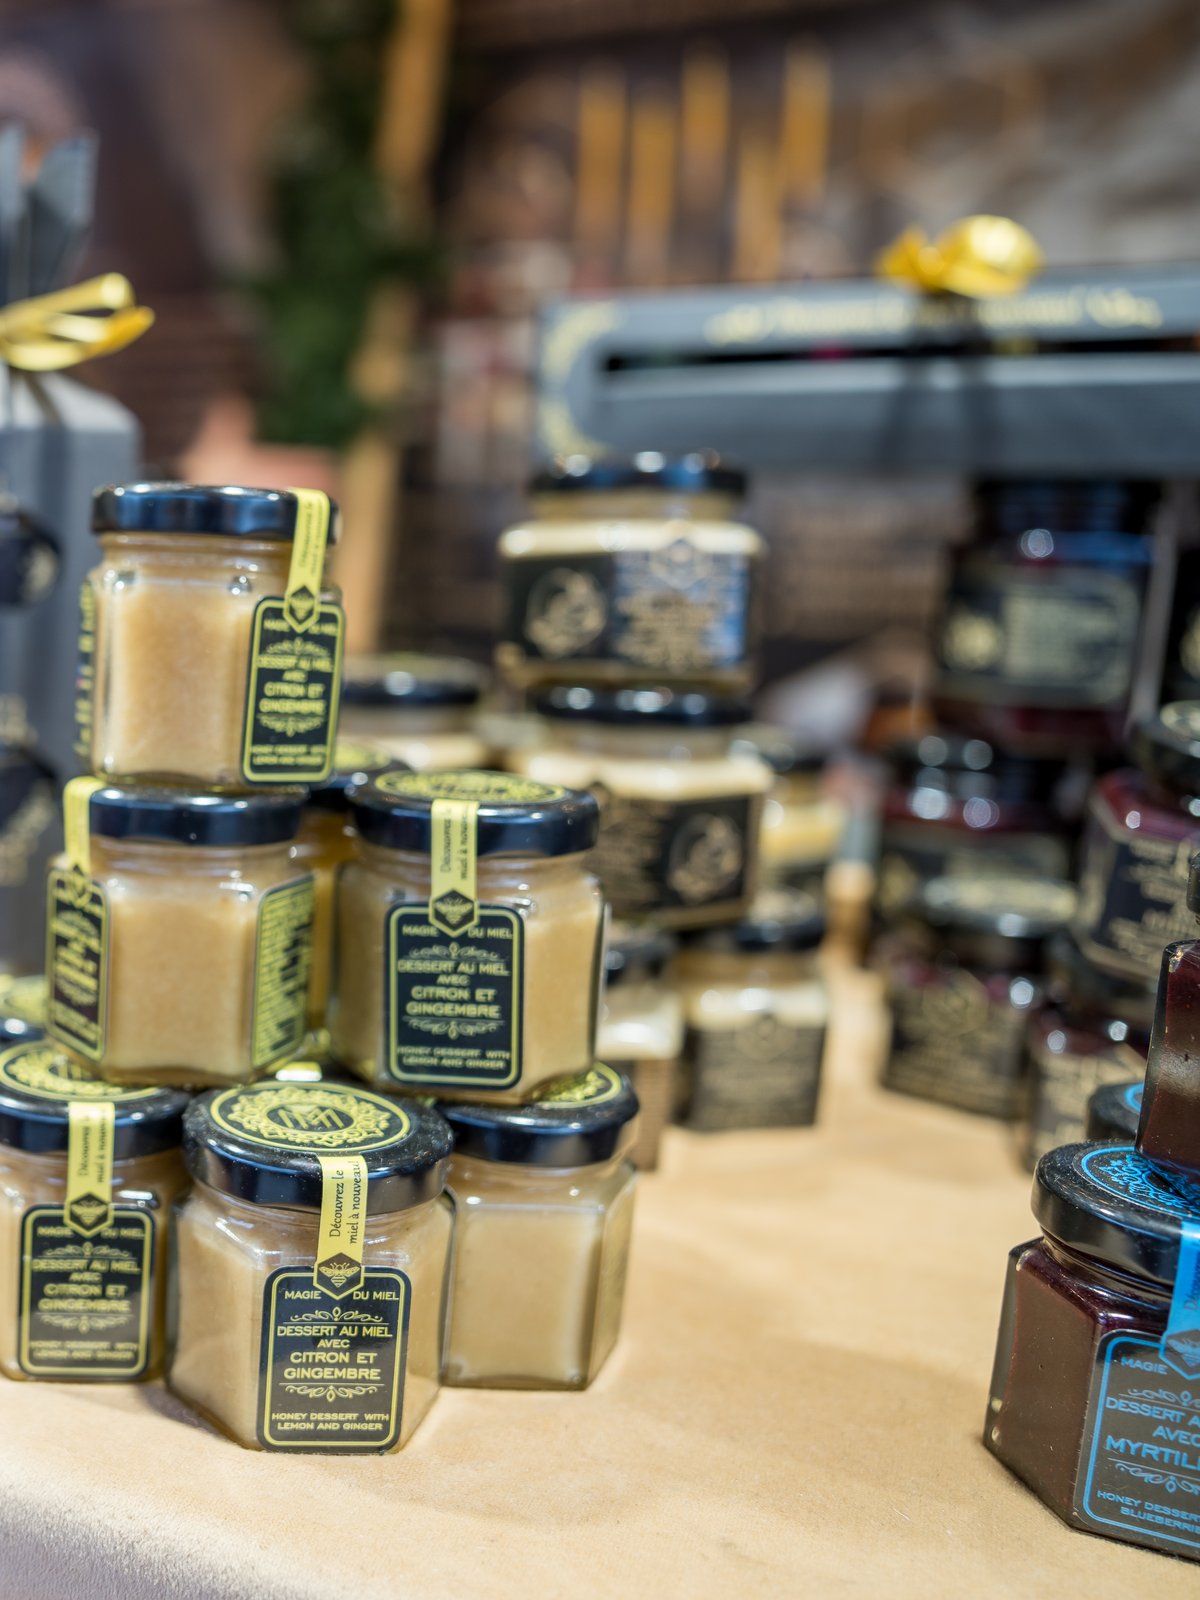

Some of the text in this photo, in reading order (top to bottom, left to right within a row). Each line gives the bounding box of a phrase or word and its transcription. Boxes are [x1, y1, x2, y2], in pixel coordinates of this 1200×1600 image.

[398, 960, 509, 976] DESSERT AU MIEL
[436, 974, 470, 985] AVEC
[411, 986, 496, 1002] CITRON ET
[406, 1002, 500, 1018] GINGEMBRE
[329, 1170, 344, 1237] Découvrez le
[346, 1222, 359, 1244] miel
[44, 1284, 128, 1298] CITRON ET
[285, 1290, 399, 1300] MAGIE DU MIEL
[38, 1298, 131, 1313] GINGEMBRE
[277, 1325, 393, 1338] DESSERT AU MIEL
[317, 1339, 350, 1348] AVEC
[290, 1352, 377, 1364] CITRON ET
[1120, 1356, 1168, 1375] MAGIE
[283, 1367, 381, 1380] GINGEMBRE
[272, 1412, 389, 1421] HONEY DESSERT WITH
[1105, 1397, 1185, 1423] DESSERT
[277, 1422, 383, 1431] LEMON AND GINGER
[1097, 1490, 1142, 1507] HONEY
